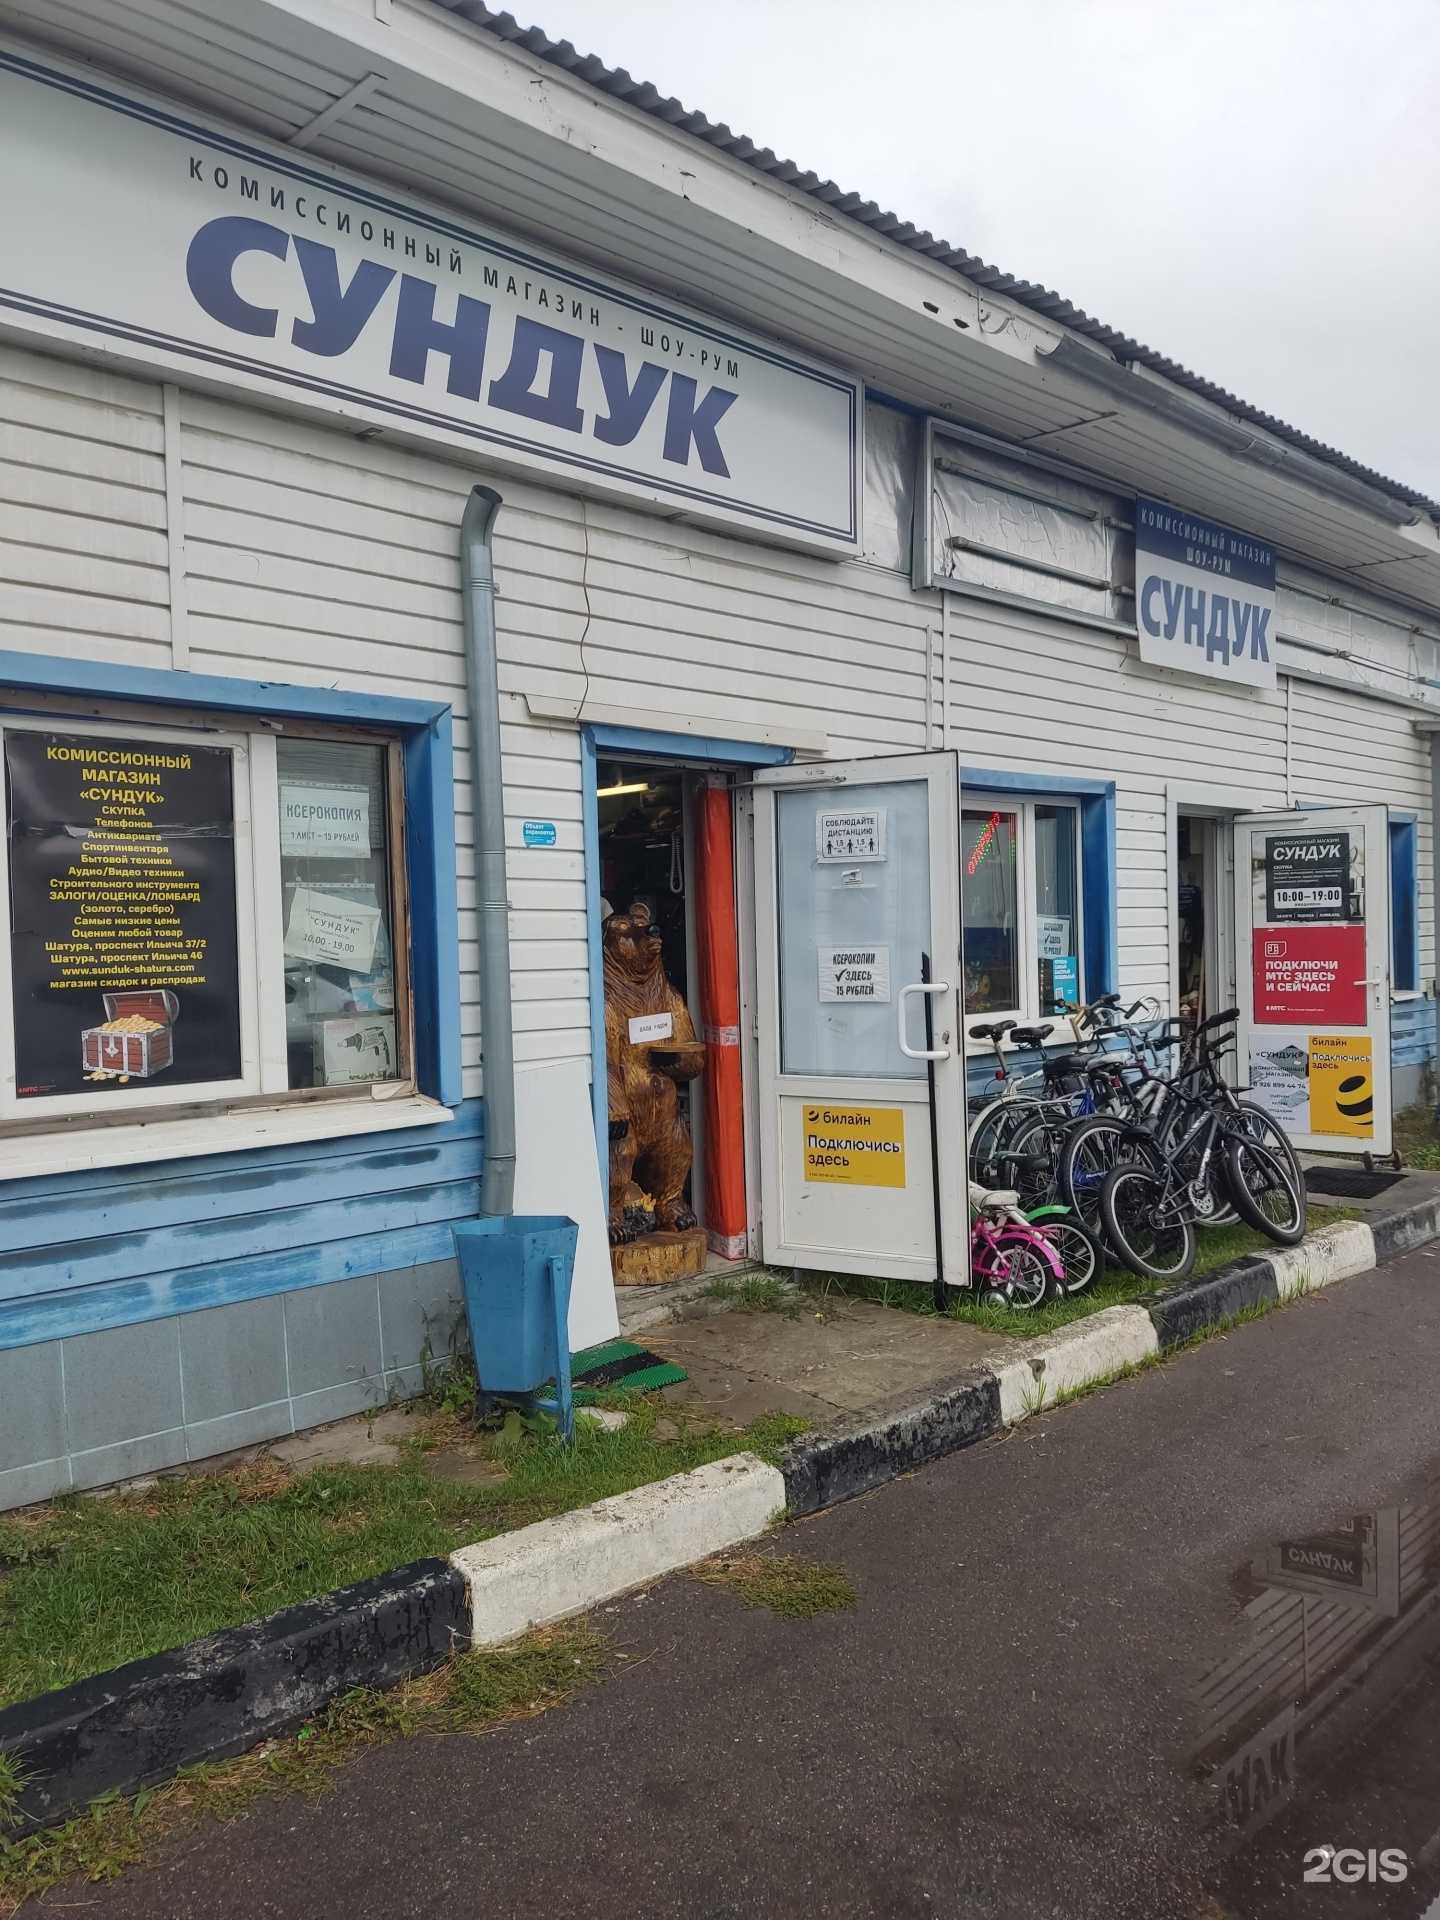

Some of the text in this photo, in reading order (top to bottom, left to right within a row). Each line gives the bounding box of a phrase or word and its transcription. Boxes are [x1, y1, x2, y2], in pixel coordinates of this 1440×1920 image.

[189, 157, 464, 275] КОМИССИОННЫЙ
[483, 266, 602, 326] МАГАЗИН
[640, 326, 741, 378] ШОУ-РУМ
[186, 215, 740, 479] СУНДУК
[1141, 508, 1271, 566] КОМИССИОННЫЙ МАГАЗИН
[1186, 547, 1231, 573] ШОУ-РУМ
[1141, 575, 1271, 666] СУНДУК
[47, 747, 191, 769] КОМИССИОННЫЙ
[82, 768, 161, 785] МАГАЗИН
[80, 788, 164, 804] «СУНДУК»
[102, 805, 145, 816] СКУПКА
[286, 804, 362, 821] КСЕРОКОПИЯ
[95, 817, 153, 829] Телефонов
[825, 816, 875, 827] СОБЛЮДАЙТЕ
[88, 830, 162, 841] Антиквариата
[827, 828, 873, 838] ДИСТАНЦИЮ
[82, 842, 169, 854] Спортинвентаря
[1273, 844, 1341, 861] СУНДУК
[81, 855, 172, 865] Бытовой техники
[69, 867, 184, 878] Аудио/Видео техники
[50, 879, 200, 890] Строительного инструмента
[50, 891, 200, 902] ЗАЛОГИ/ОЦЕНКА/ЛОМБАРД
[81, 904, 174, 914] (золото, серебро)
[74, 916, 180, 926] Самые низкие цены
[71, 928, 183, 939] Оценим любой товар
[45, 940, 207, 952] Шатура, проспект Ильича 37/2
[51, 951, 203, 964] Шатура, проспект Ильича 46
[832, 953, 876, 965] КСЕРОКОПИИ
[62, 964, 195, 976] www.sunduk-shatura.com
[1265, 960, 1338, 971] ПОДКЛЮЧИ
[844, 969, 872, 981] ЗДЕСЬ
[1265, 971, 1335, 982] МТС ЗДЕСЬ
[50, 979, 97, 989] магазин
[100, 978, 138, 988] скидок
[150, 976, 206, 987] распродаж
[1265, 980, 1331, 992] И СЕЙЧАС!
[836, 983, 874, 995] 15 РУБЛЕЙ
[1311, 1037, 1347, 1047] билайн
[1311, 1052, 1371, 1063] Подключись
[1311, 1062, 1339, 1070] здесь
[823, 1111, 871, 1126] билайн
[808, 1134, 900, 1153] Подключись
[808, 1154, 850, 1167] здесь
